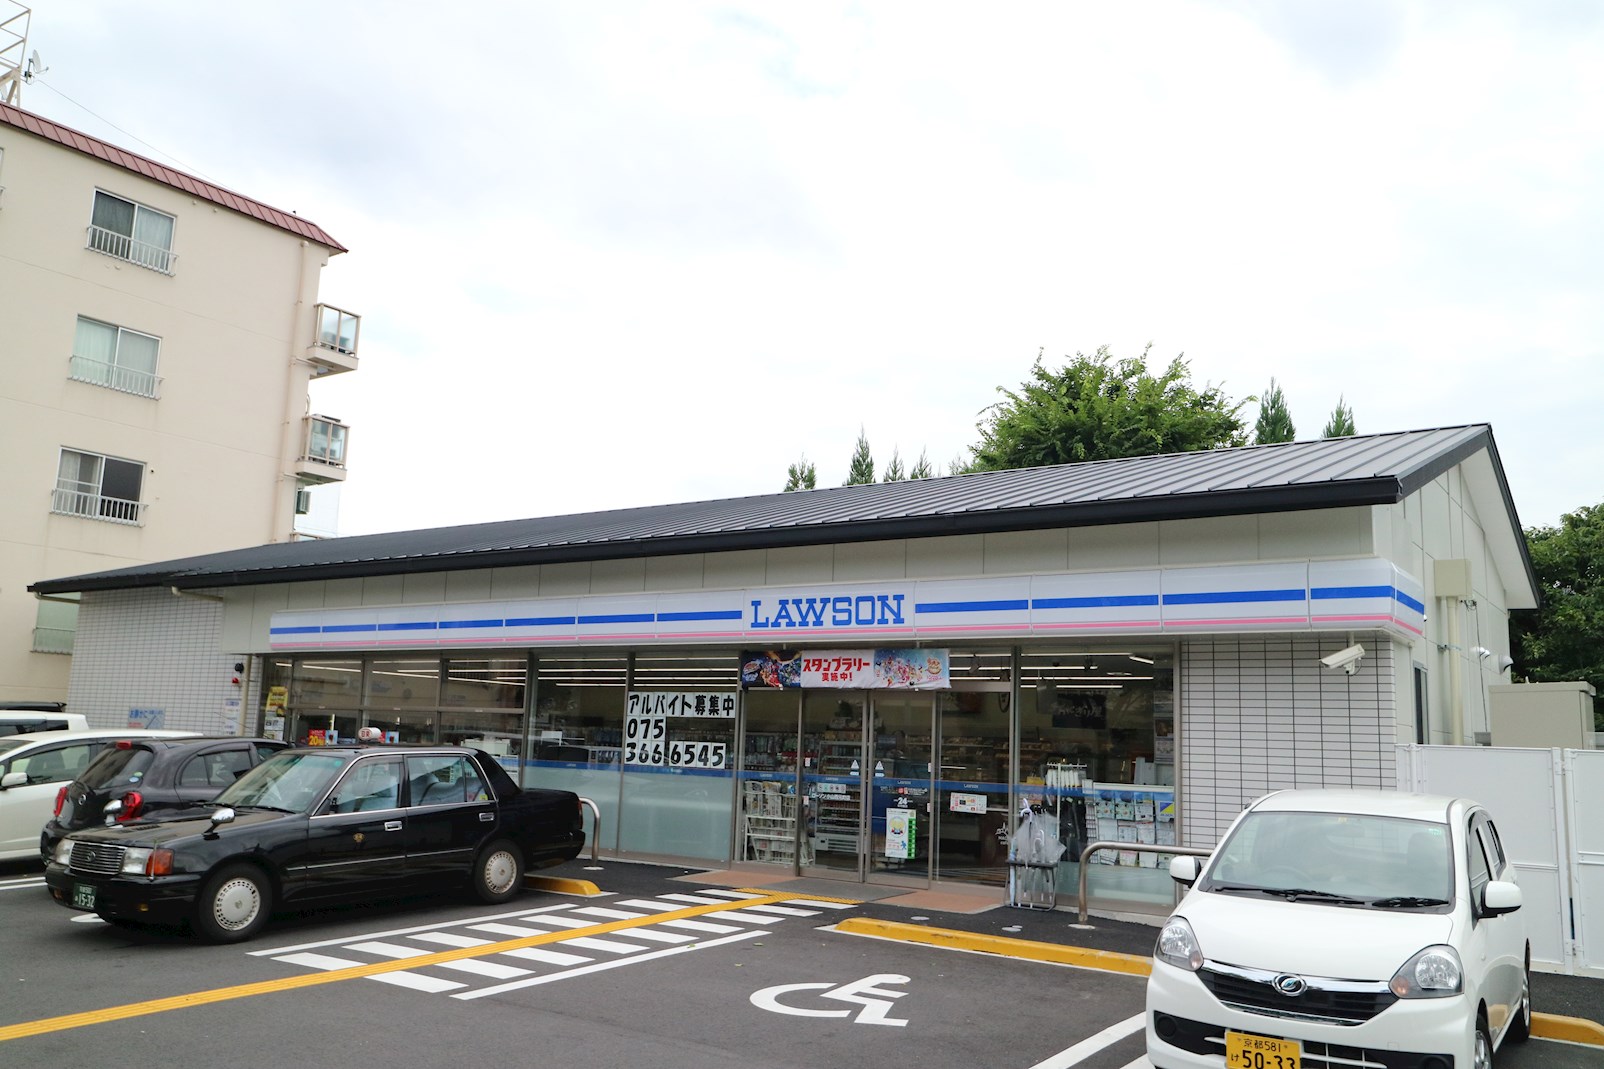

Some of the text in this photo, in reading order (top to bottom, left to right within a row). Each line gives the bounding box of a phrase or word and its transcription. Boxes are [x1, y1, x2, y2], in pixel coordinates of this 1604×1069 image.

[750, 594, 905, 628] LAWSON
[802, 658, 870, 672] スタンプラリー
[821, 672, 853, 682] 実施中!
[629, 694, 735, 717] アルバイト募集中
[627, 718, 664, 739] 075
[625, 742, 725, 767] 366 6545
[78, 893, 96, 908] 15-32
[1243, 1038, 1281, 1053] 京都581
[1230, 1053, 1240, 1062] け
